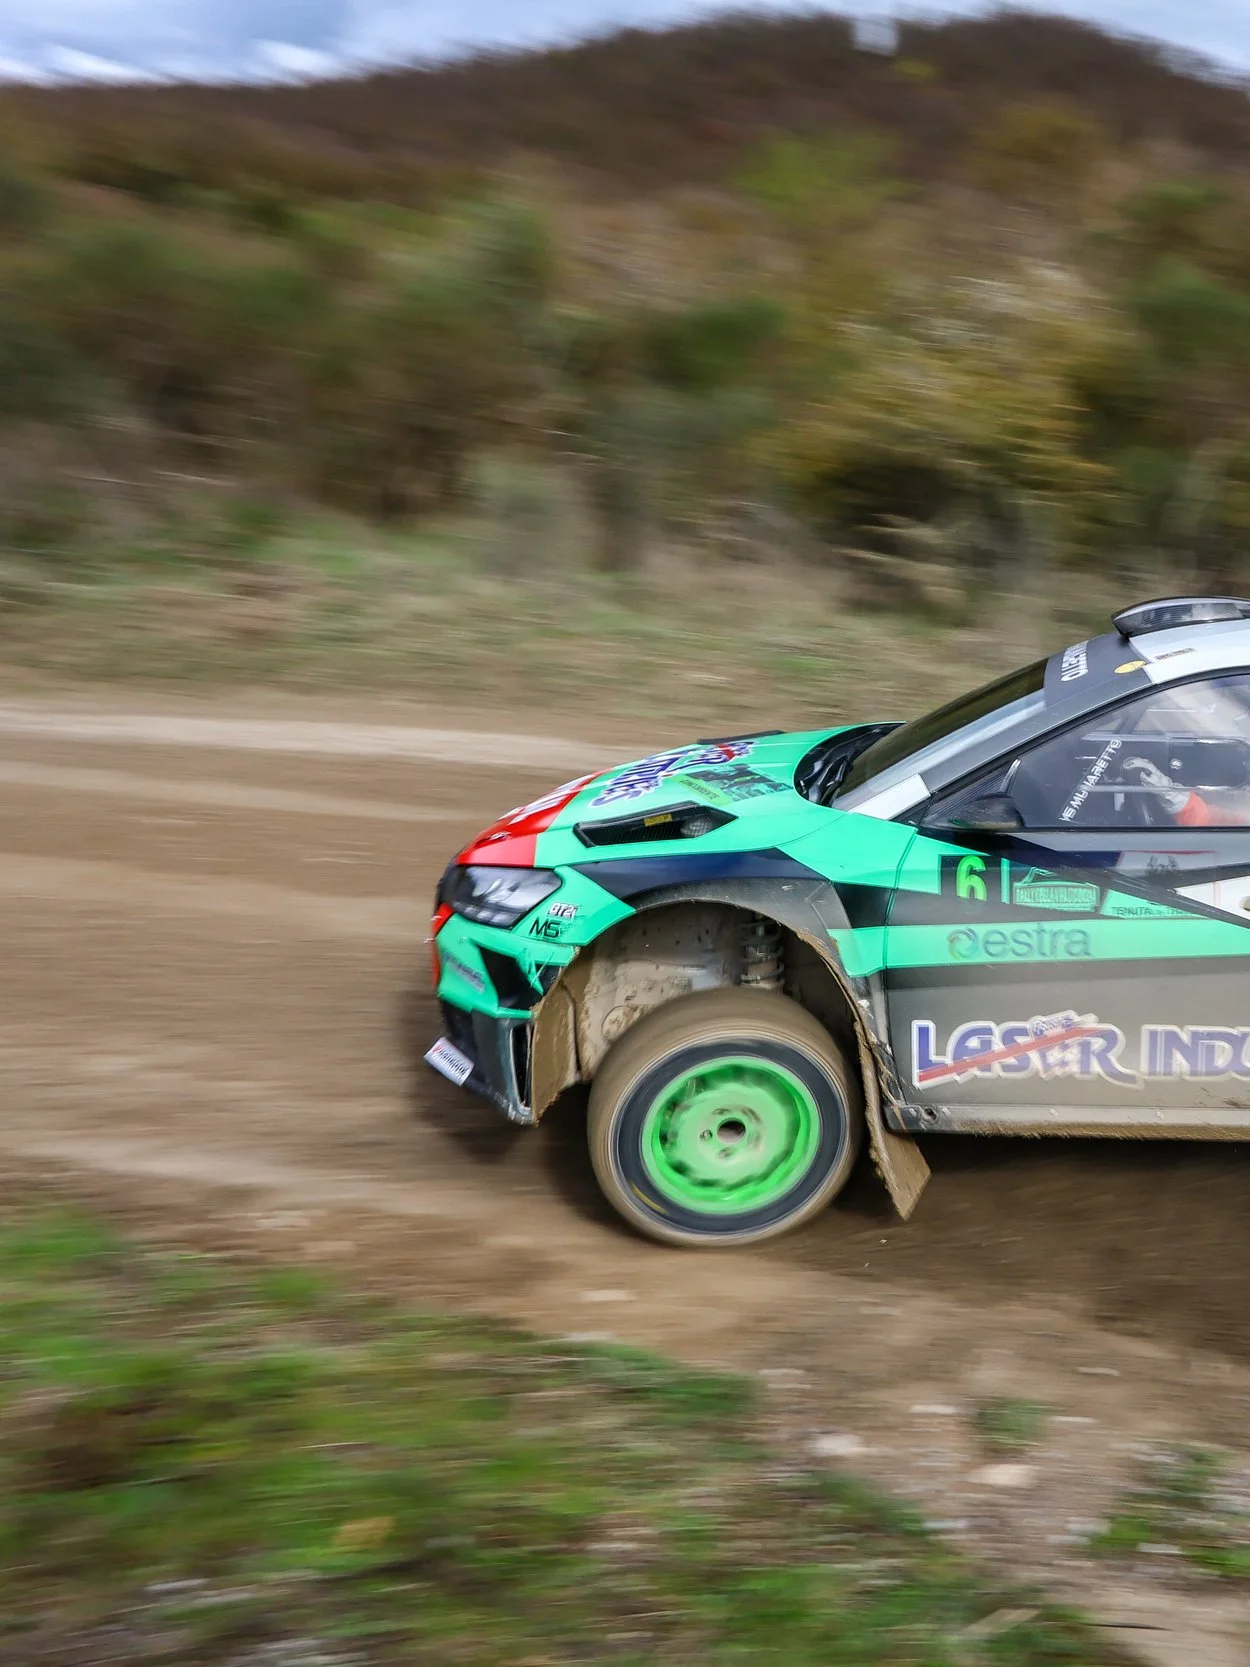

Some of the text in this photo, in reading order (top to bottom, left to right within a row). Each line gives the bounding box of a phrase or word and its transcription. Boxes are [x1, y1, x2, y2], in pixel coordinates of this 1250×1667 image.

[956, 855, 988, 902] 6
[529, 917, 562, 938] MS
[913, 1011, 1143, 1088] LASER
